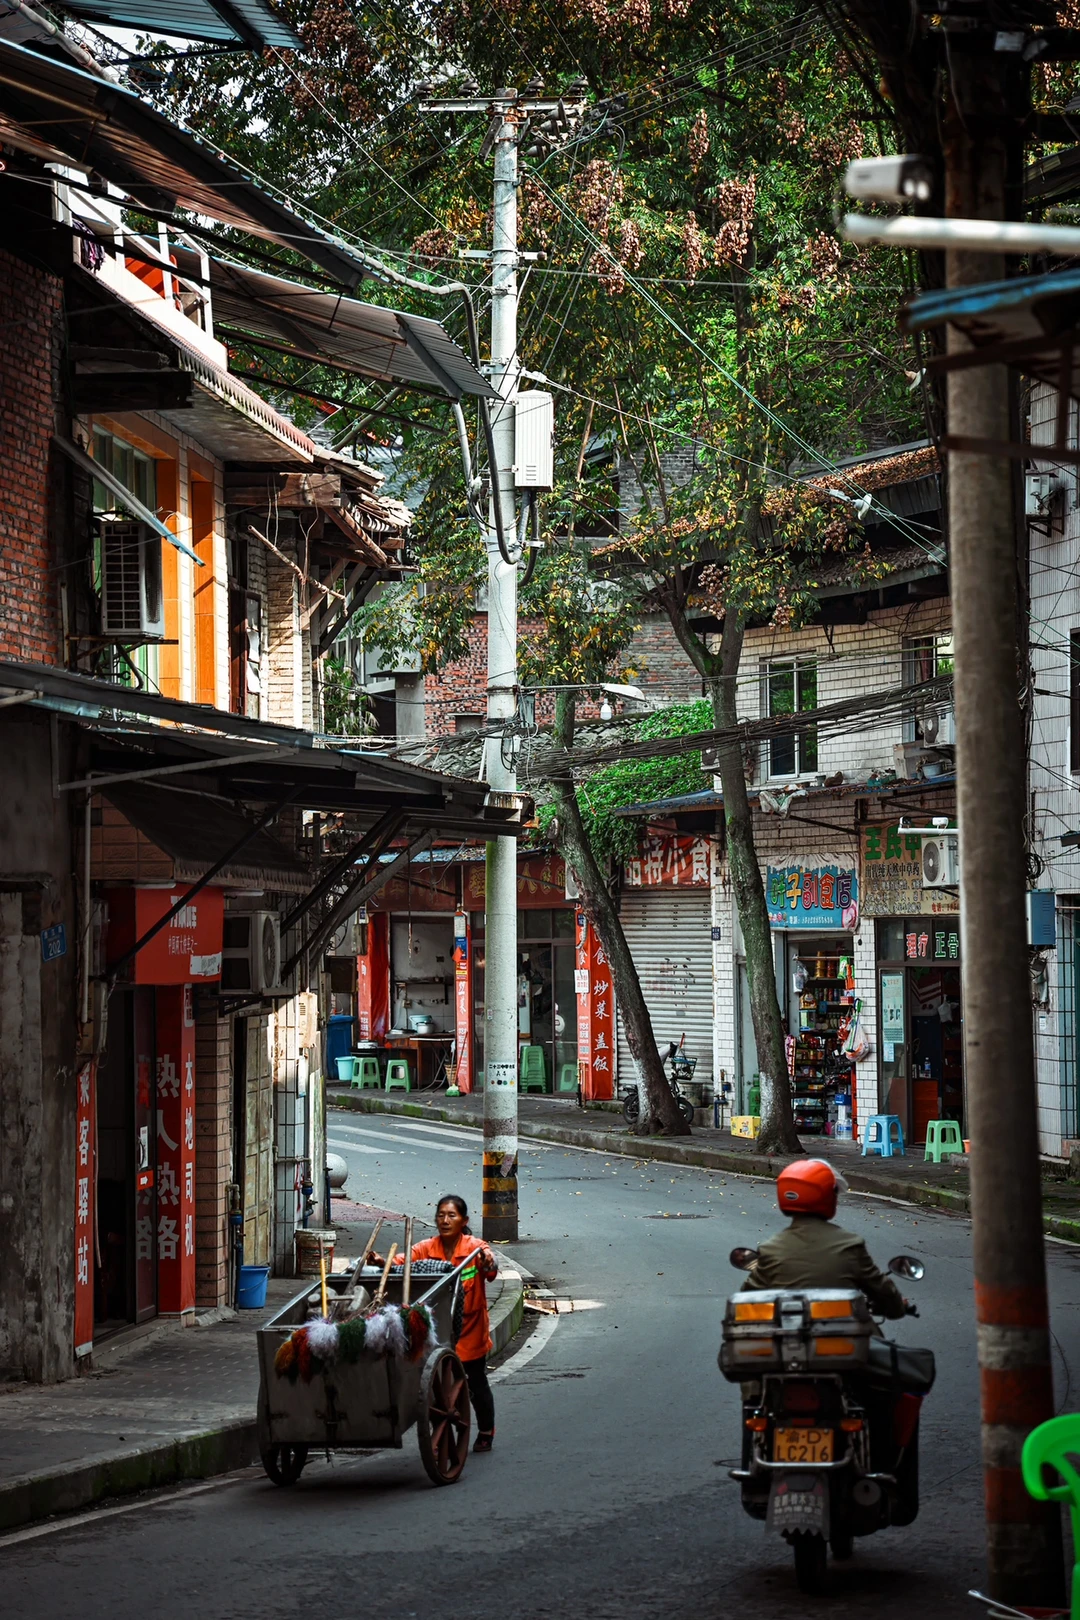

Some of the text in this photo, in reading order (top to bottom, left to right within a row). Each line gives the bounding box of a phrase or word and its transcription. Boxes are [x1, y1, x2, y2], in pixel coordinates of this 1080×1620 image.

[771, 872, 852, 909] 叶子副食店
[48, 939, 61, 956] 202
[906, 932, 959, 958] 理疗 正骨
[593, 980, 610, 1020] 炒菜
[592, 1032, 609, 1072] 盖饭
[184, 1053, 194, 1257] 本地司机
[776, 1445, 829, 1462] LC216
